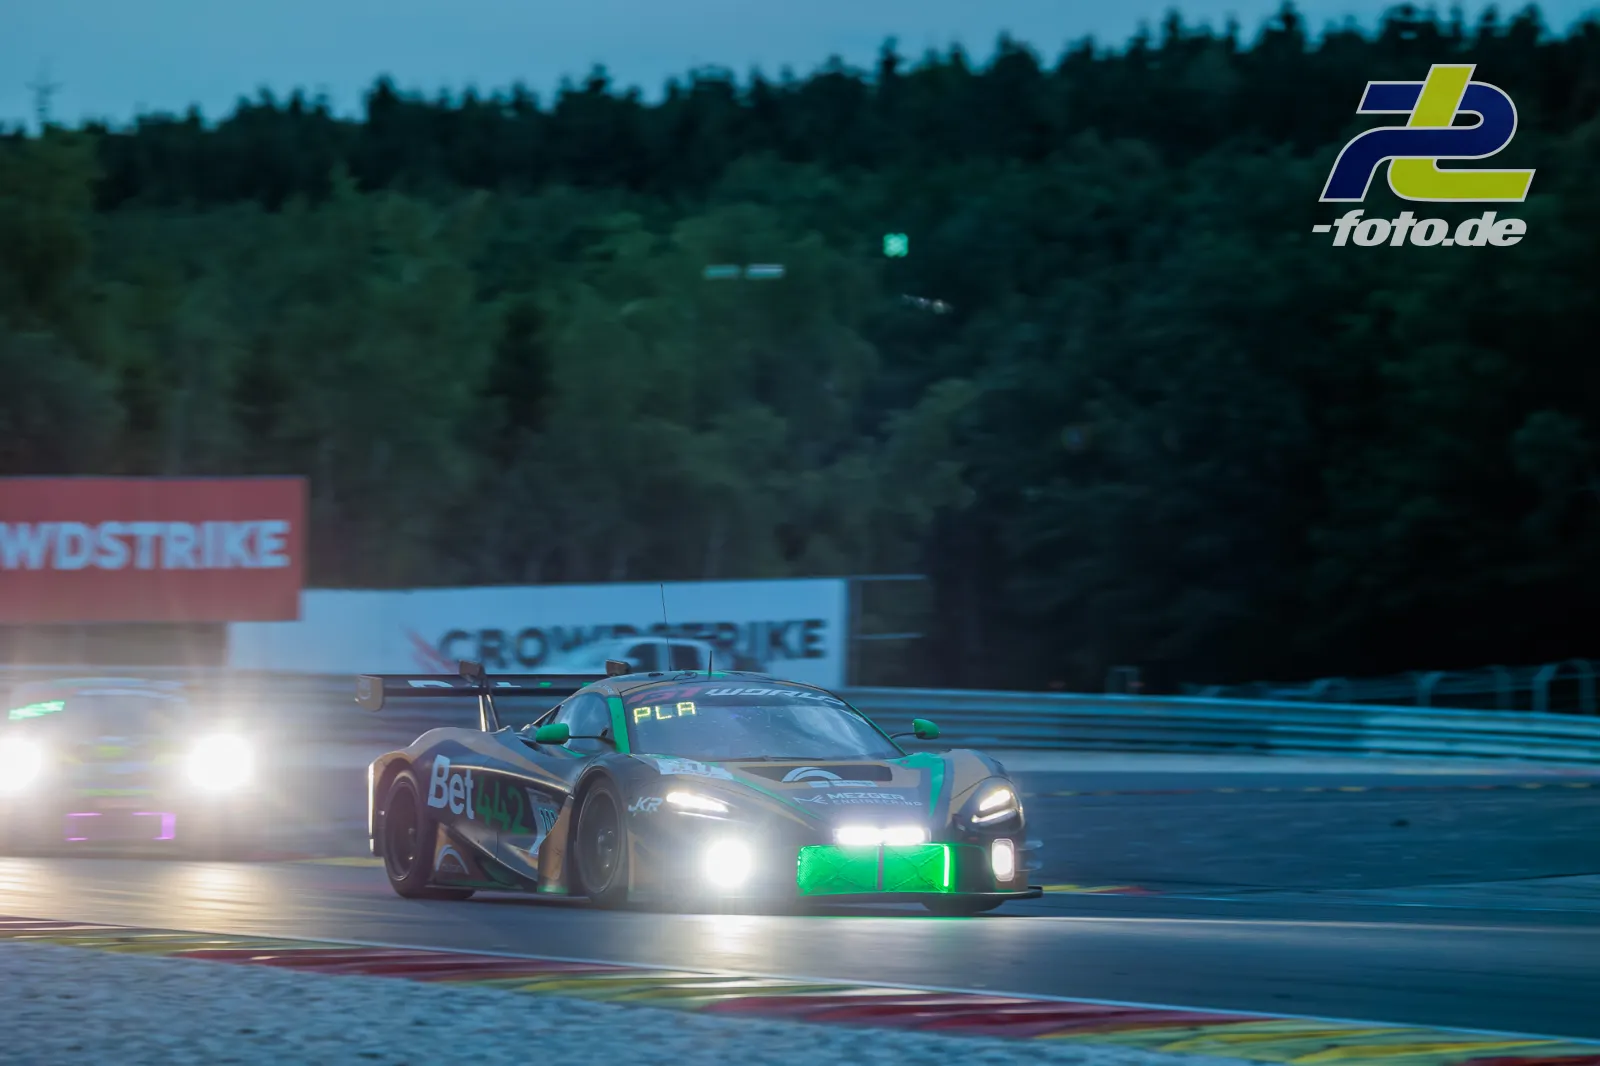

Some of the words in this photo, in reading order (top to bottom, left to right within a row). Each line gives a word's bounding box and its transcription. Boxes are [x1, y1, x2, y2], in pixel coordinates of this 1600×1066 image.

[632, 701, 697, 725] PLA
[427, 753, 532, 836] Bet442
[826, 791, 905, 802] MEZGER
